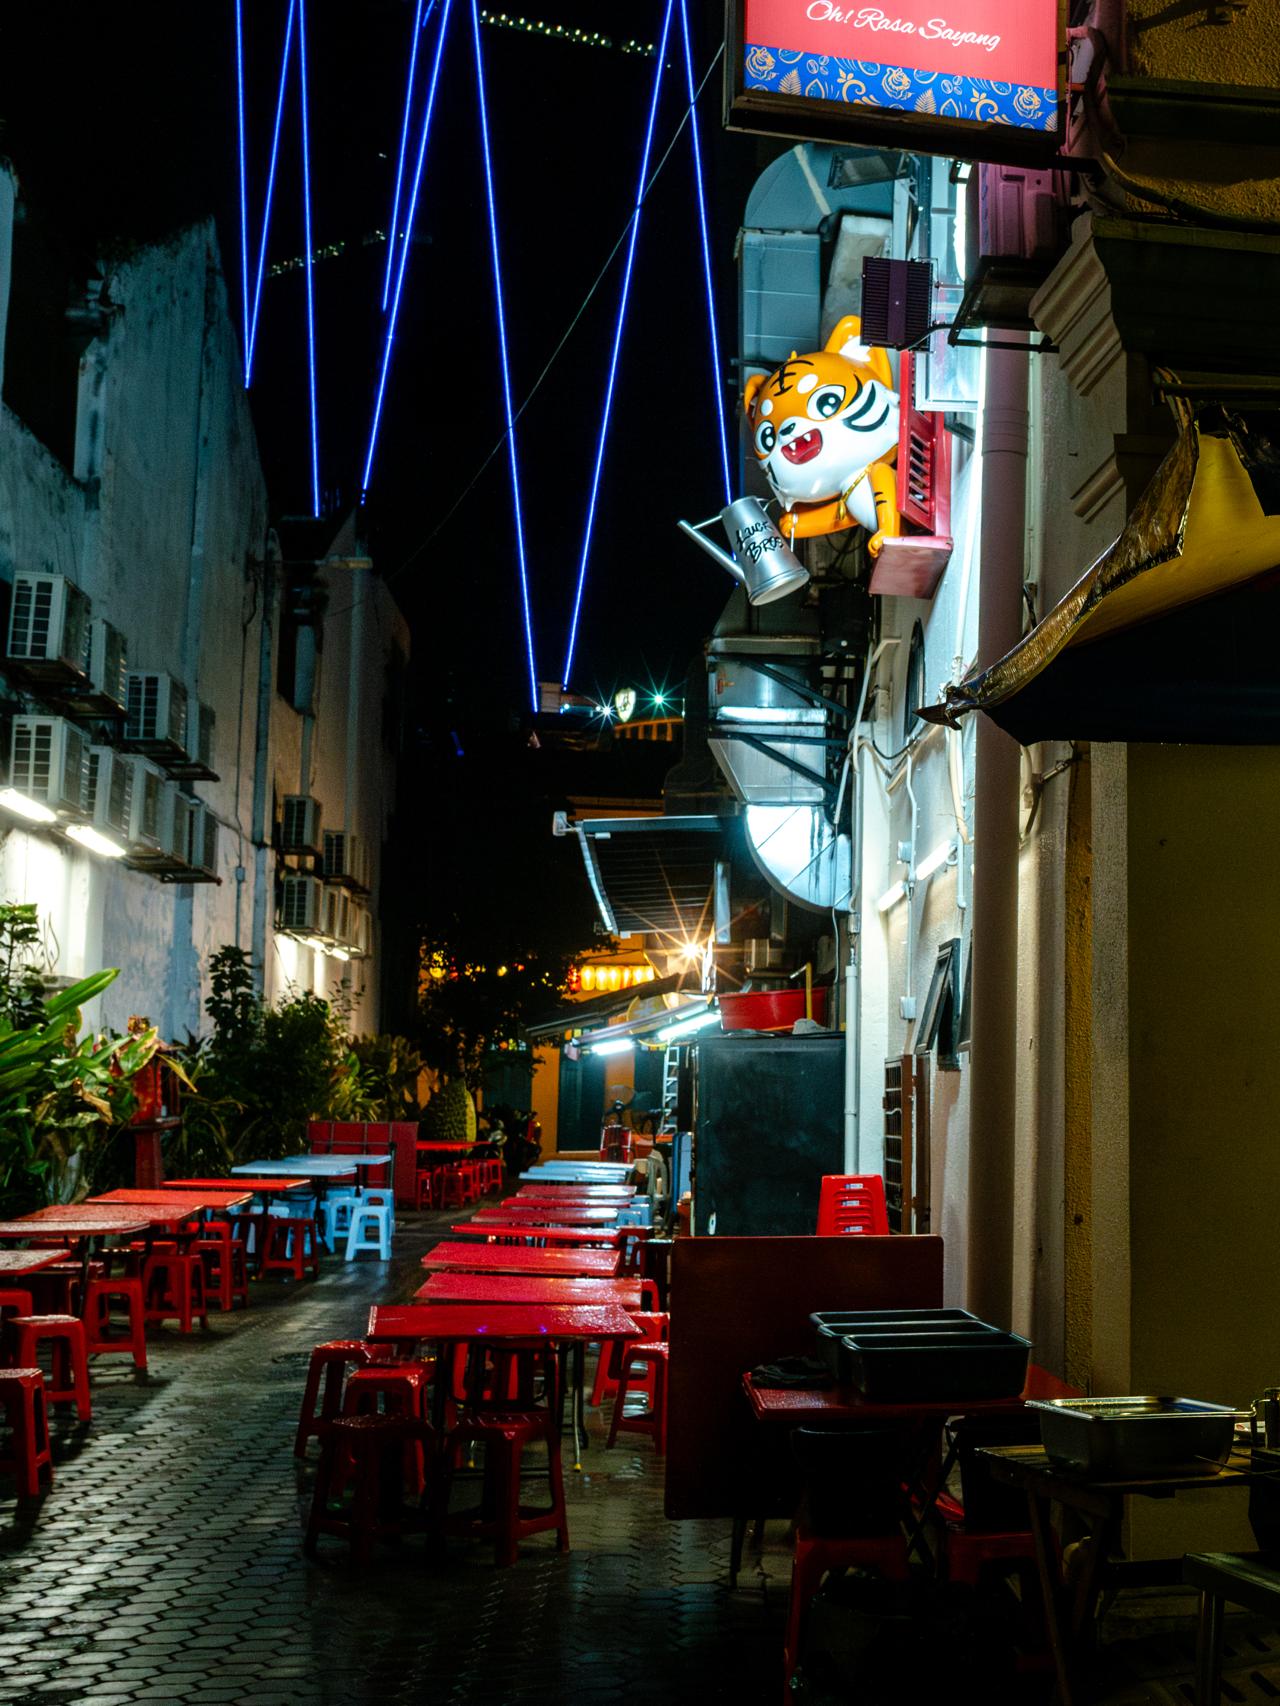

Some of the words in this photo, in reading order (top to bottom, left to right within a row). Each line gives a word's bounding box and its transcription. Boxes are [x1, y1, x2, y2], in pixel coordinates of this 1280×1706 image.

[806, 0, 855, 24] Oh!
[853, 7, 916, 34] Rasa
[918, 18, 1001, 52] Sayang
